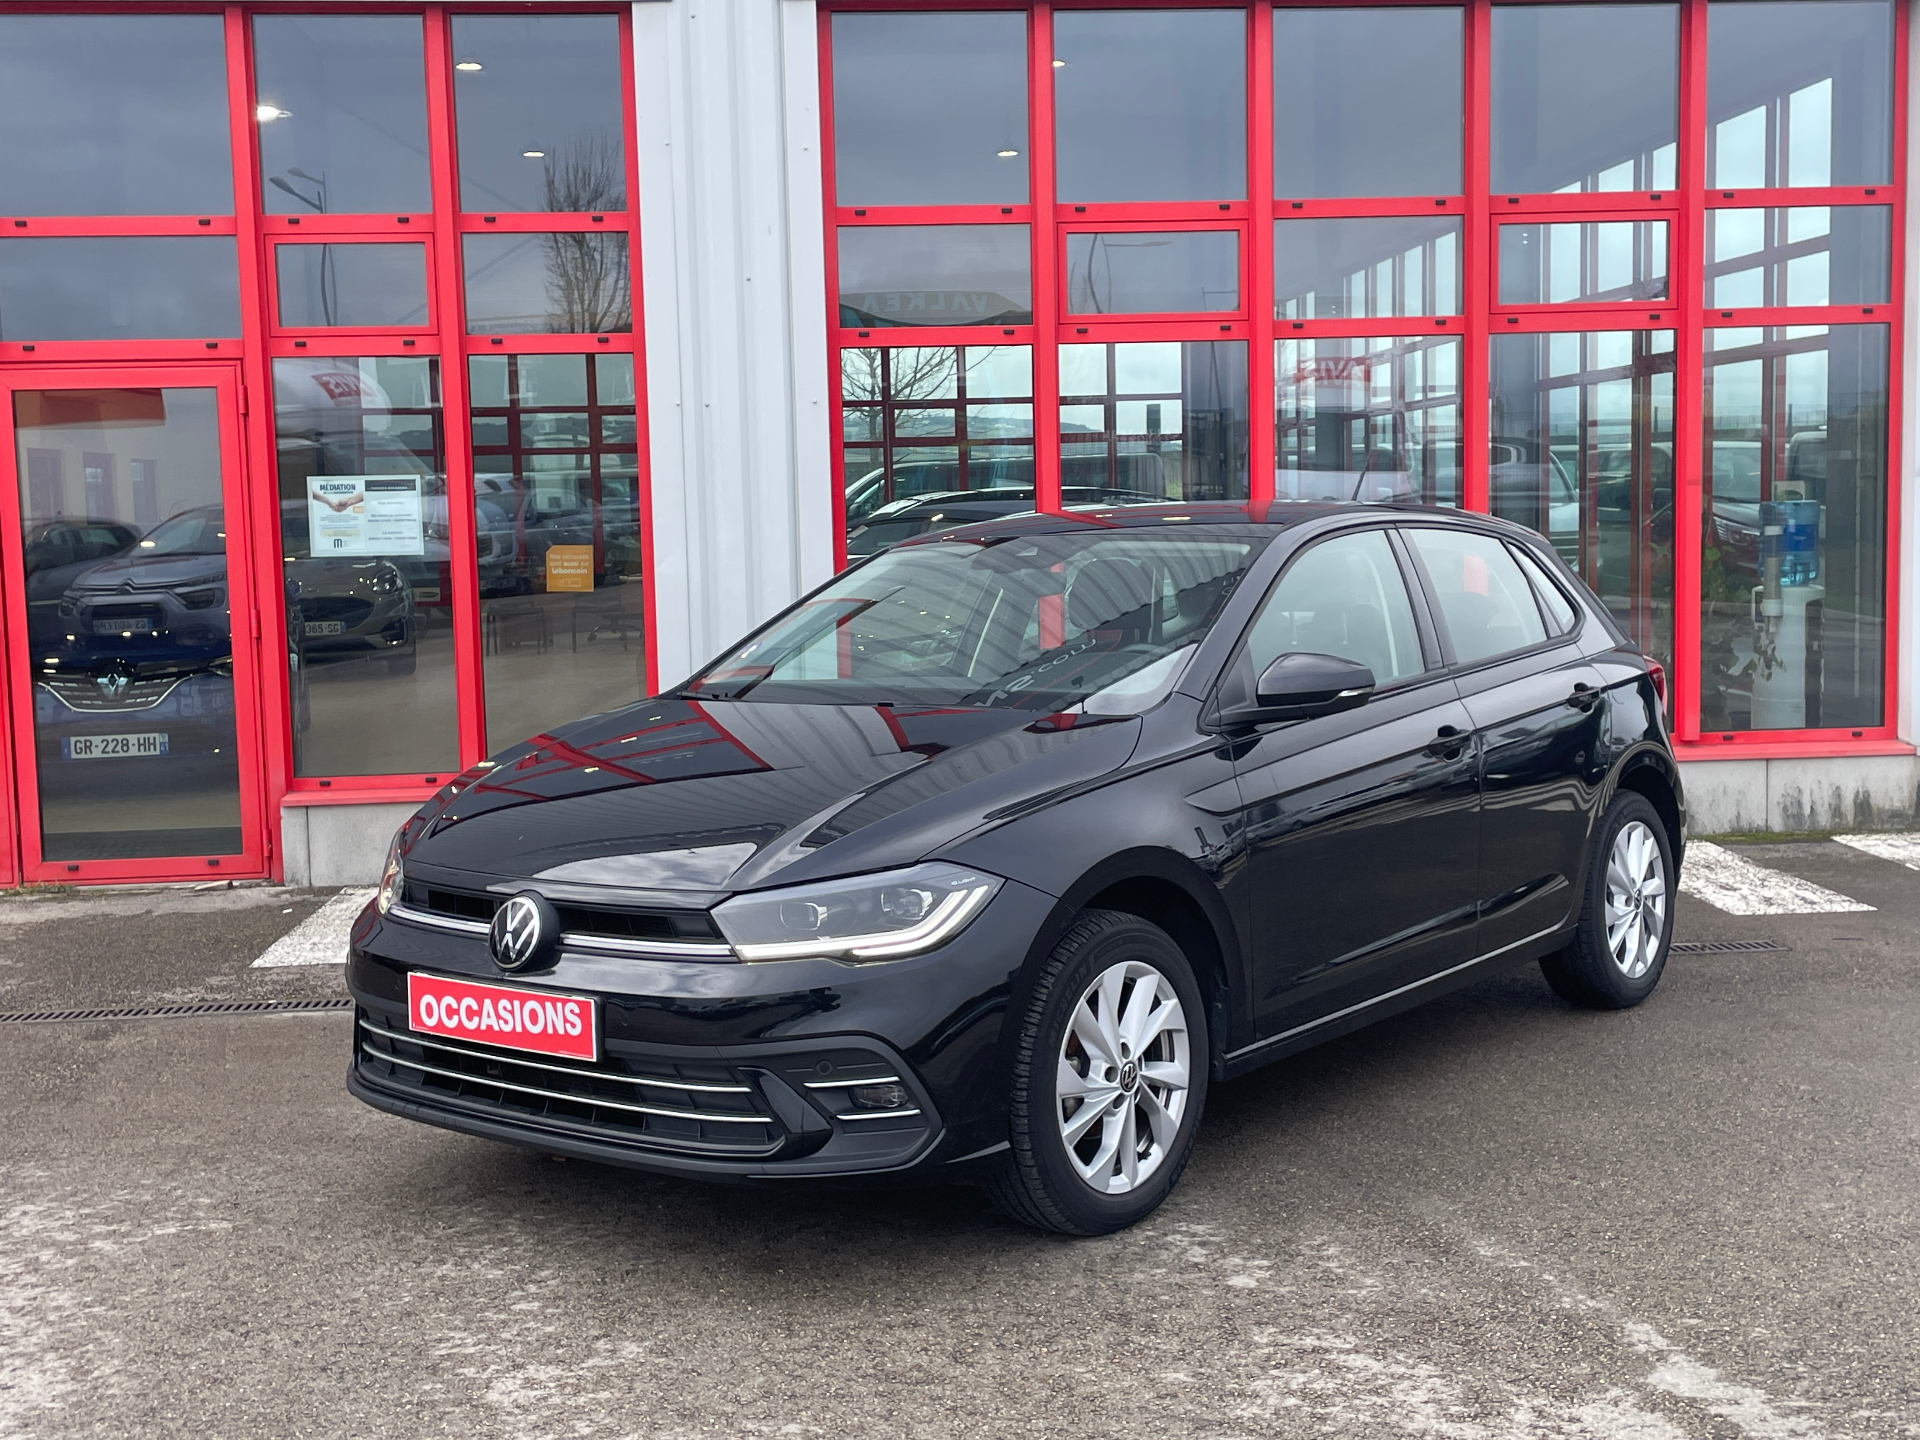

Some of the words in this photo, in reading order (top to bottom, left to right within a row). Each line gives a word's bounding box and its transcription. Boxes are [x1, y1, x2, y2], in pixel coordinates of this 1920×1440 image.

[74, 736, 157, 756] GR-228-HH
[419, 994, 583, 1037] OCCASIONS
[1048, 961, 1089, 1048] MICHELIN
